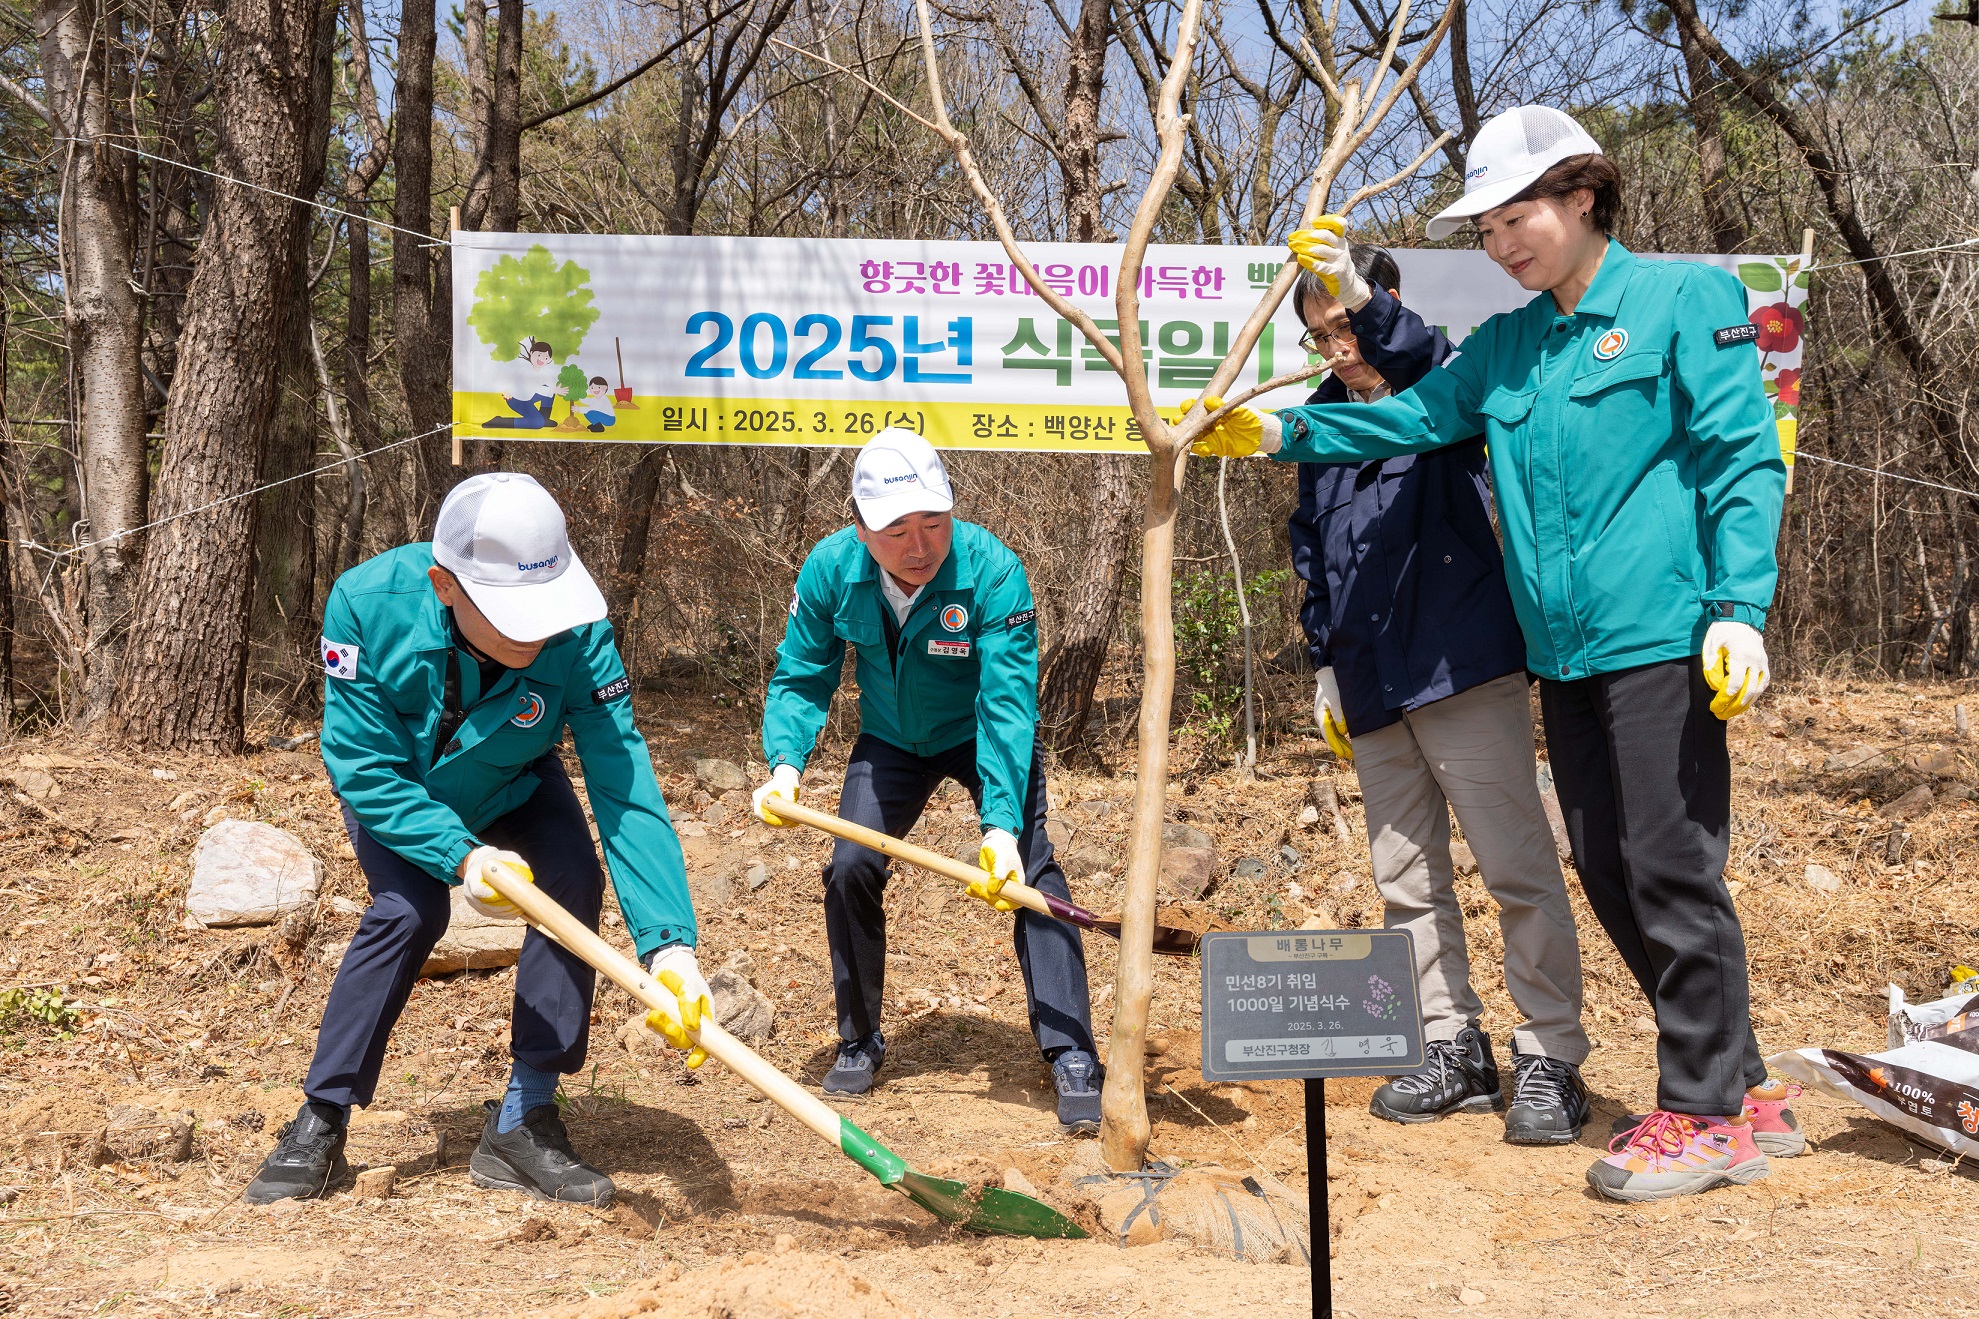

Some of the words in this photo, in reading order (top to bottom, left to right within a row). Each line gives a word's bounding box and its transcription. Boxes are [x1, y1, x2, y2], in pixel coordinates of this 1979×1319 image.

[859, 259, 963, 295] 향긋한
[1719, 325, 1758, 341] 부산진구
[685, 310, 973, 384] 2025년
[661, 406, 708, 432] 일시
[733, 410, 803, 433] 2025.
[812, 410, 834, 433] 3.
[971, 412, 1020, 439] 장소
[1044, 415, 1117, 442] 백양산
[883, 473, 918, 484] busanjin
[517, 555, 559, 571] busanjin
[1007, 610, 1035, 626] 부산진구
[597, 679, 630, 700] 부산진구
[1276, 937, 1343, 952] 배롱나무
[1225, 974, 1282, 991] 민선8기
[1286, 973, 1317, 990] 취임
[1227, 996, 1284, 1013] 1000일
[1289, 994, 1351, 1012] 기념식수
[1287, 1021, 1315, 1032] 2025.
[1317, 1021, 1326, 1031] 3.
[1329, 1021, 1344, 1031] 26.
[1242, 1042, 1311, 1057] 부산진구청장
[1893, 1082, 1936, 1105] 100%
